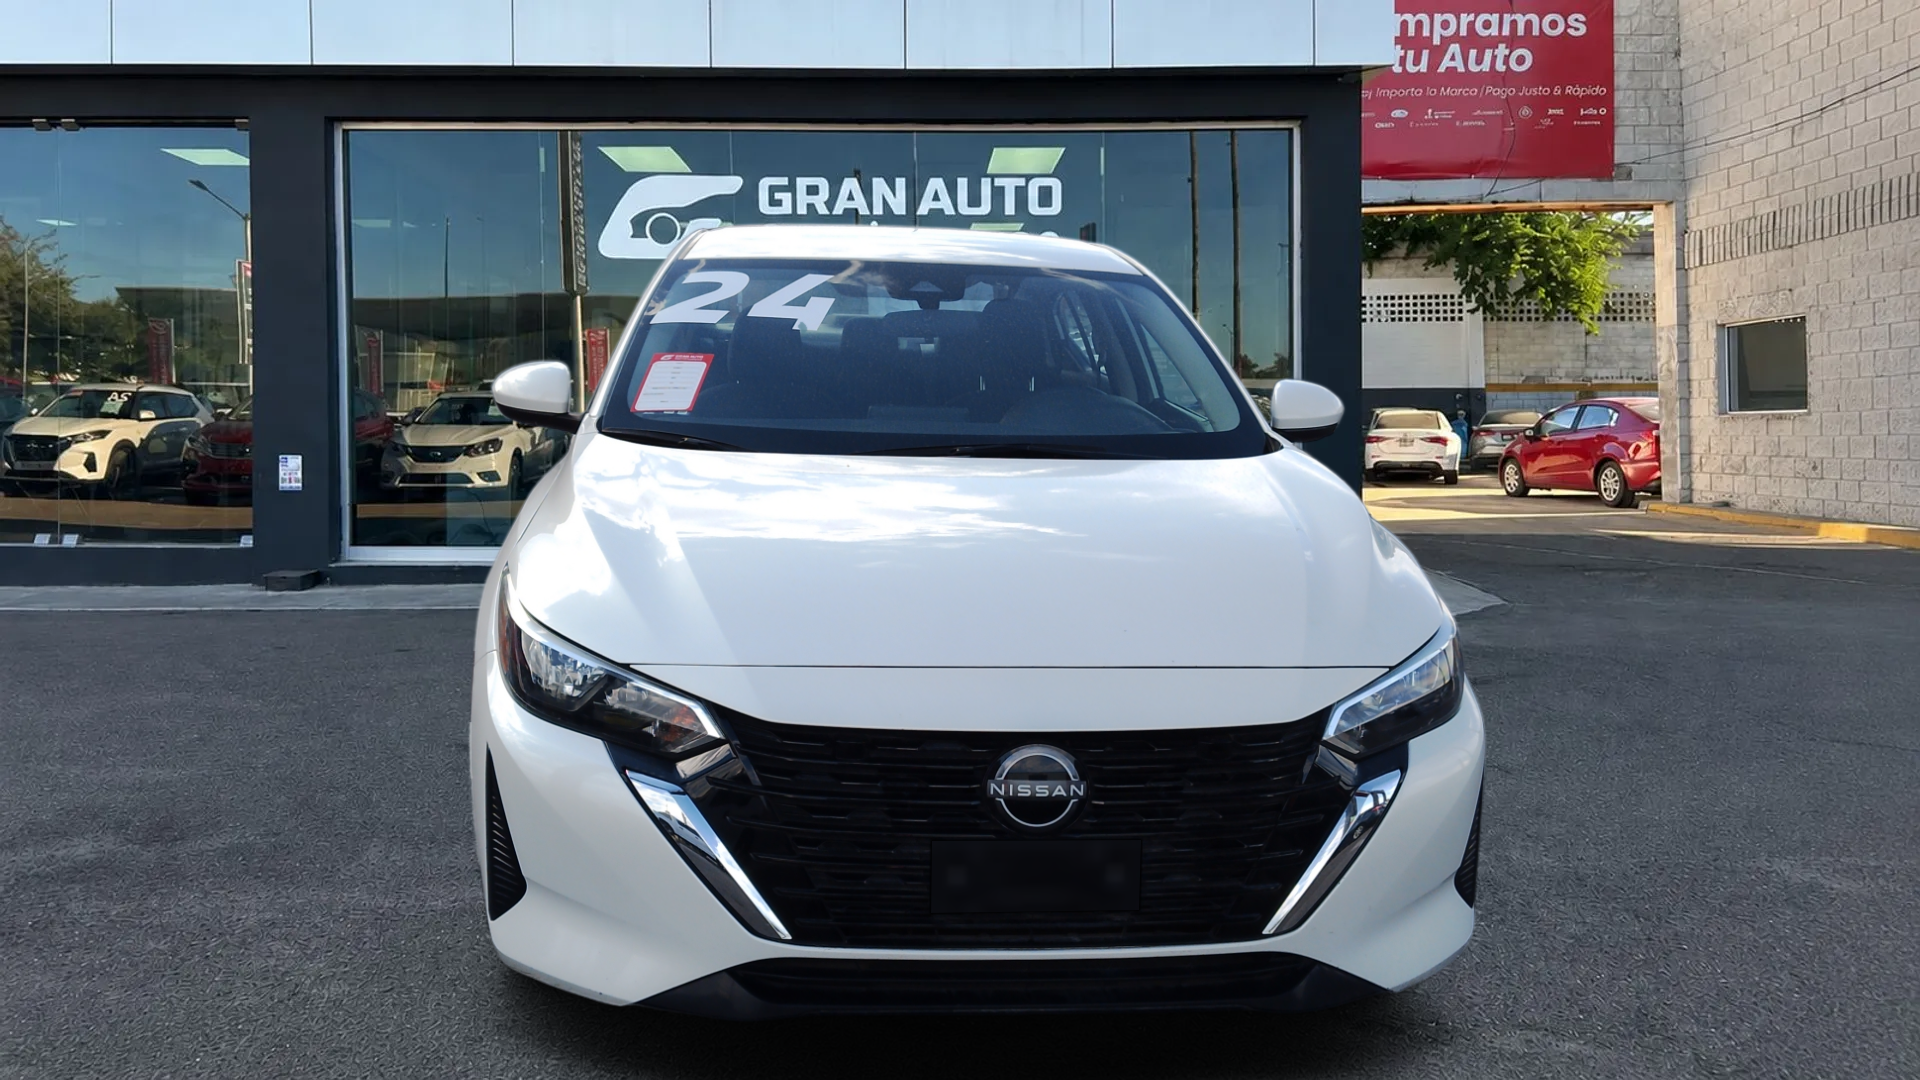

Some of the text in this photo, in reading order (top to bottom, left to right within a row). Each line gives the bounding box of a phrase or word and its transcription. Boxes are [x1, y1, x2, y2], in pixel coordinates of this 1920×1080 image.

[1393, 43, 1533, 73] tu Auto
[1376, 87, 1423, 99] Importa
[1426, 86, 1437, 97] la
[1440, 86, 1478, 96] Marca
[1519, 86, 1550, 96] Justo
[1553, 86, 1561, 96] &
[1565, 84, 1607, 98] Rápido
[758, 176, 1063, 216] GRAN AUTO
[650, 270, 836, 331] 24
[990, 783, 1084, 797] NISSAN
